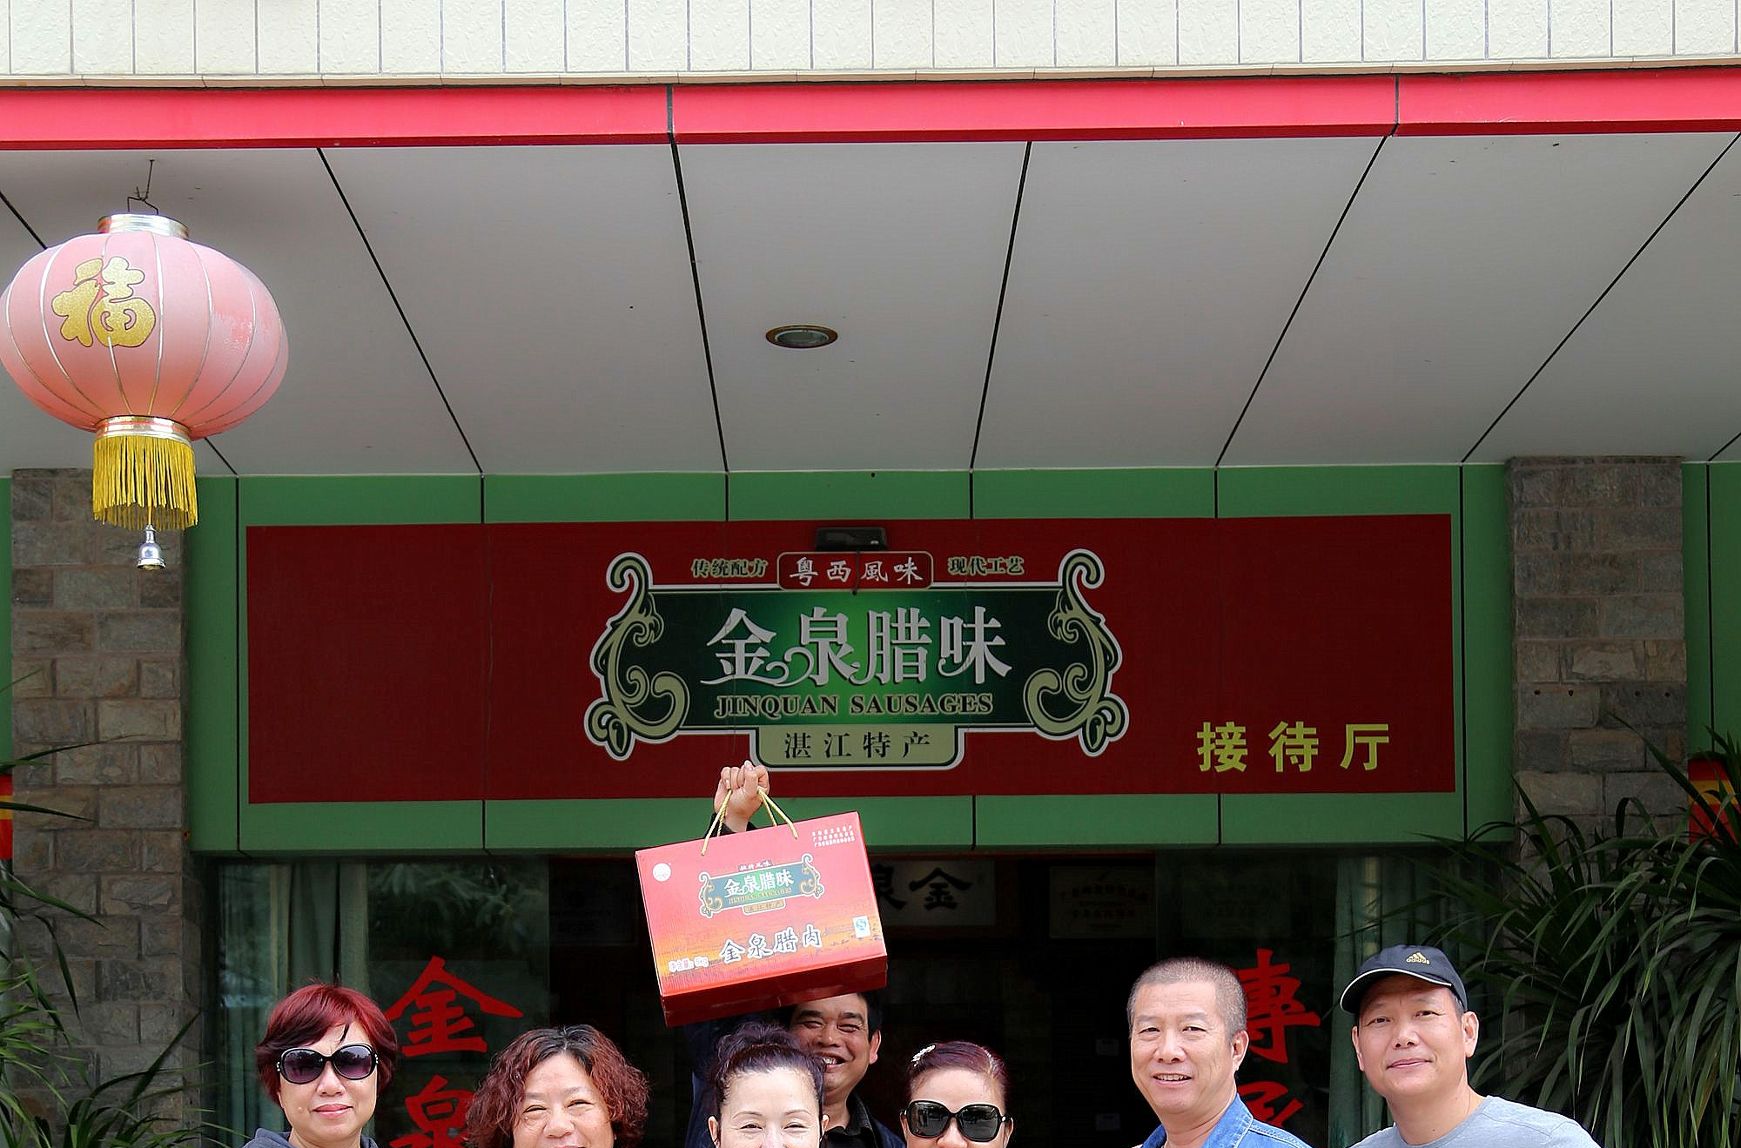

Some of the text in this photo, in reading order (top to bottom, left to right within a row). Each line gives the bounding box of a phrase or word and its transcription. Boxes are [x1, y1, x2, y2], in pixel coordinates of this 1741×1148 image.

[52, 256, 156, 347] 福
[691, 558, 768, 577] 传统配方
[789, 557, 924, 586] 粤西風味
[947, 556, 1024, 576] 现代工艺
[701, 606, 1012, 686] 金泉腊味
[714, 693, 993, 717] JINQUAN SAUSAGES
[784, 732, 930, 759] 湛江特产
[1197, 721, 1390, 773] 接待厅
[724, 868, 794, 898] 金泉腊味
[719, 924, 823, 964] 金泉腊肉
